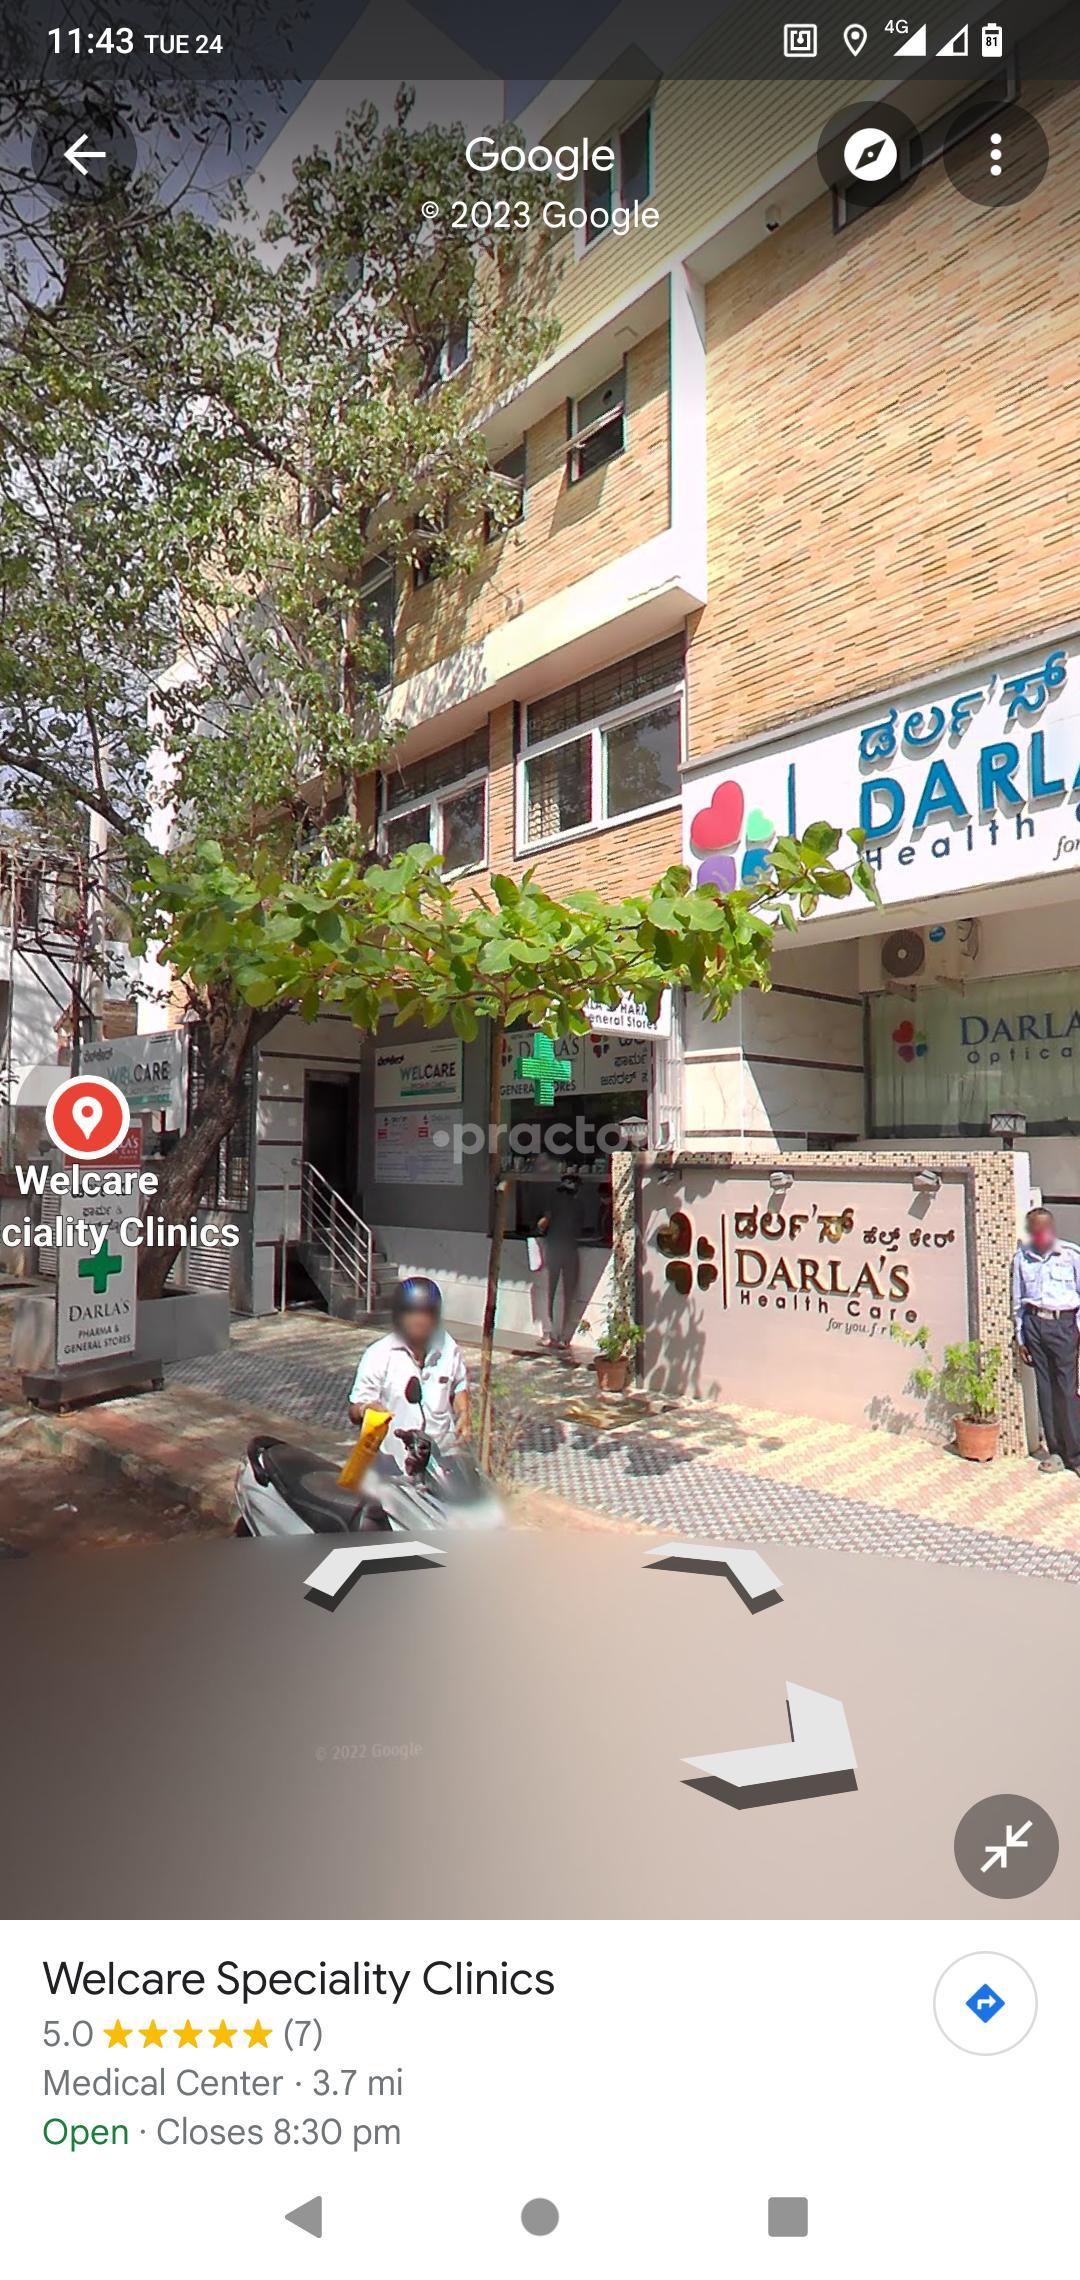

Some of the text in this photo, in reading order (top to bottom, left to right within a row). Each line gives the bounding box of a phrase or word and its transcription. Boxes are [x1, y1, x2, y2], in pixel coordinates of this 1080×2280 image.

[860, 729, 1080, 842] DARL
[865, 812, 1036, 872] Health
[400, 1062, 457, 1080] WELCARE
[734, 1248, 912, 1302] DARLA'S
[69, 1299, 130, 1322] DARLA'S
[740, 1289, 918, 1323] Health Care
[78, 1325, 112, 1338] PHARMA
[826, 1317, 844, 1332] for
[64, 1334, 131, 1354] GENERAL STORES
